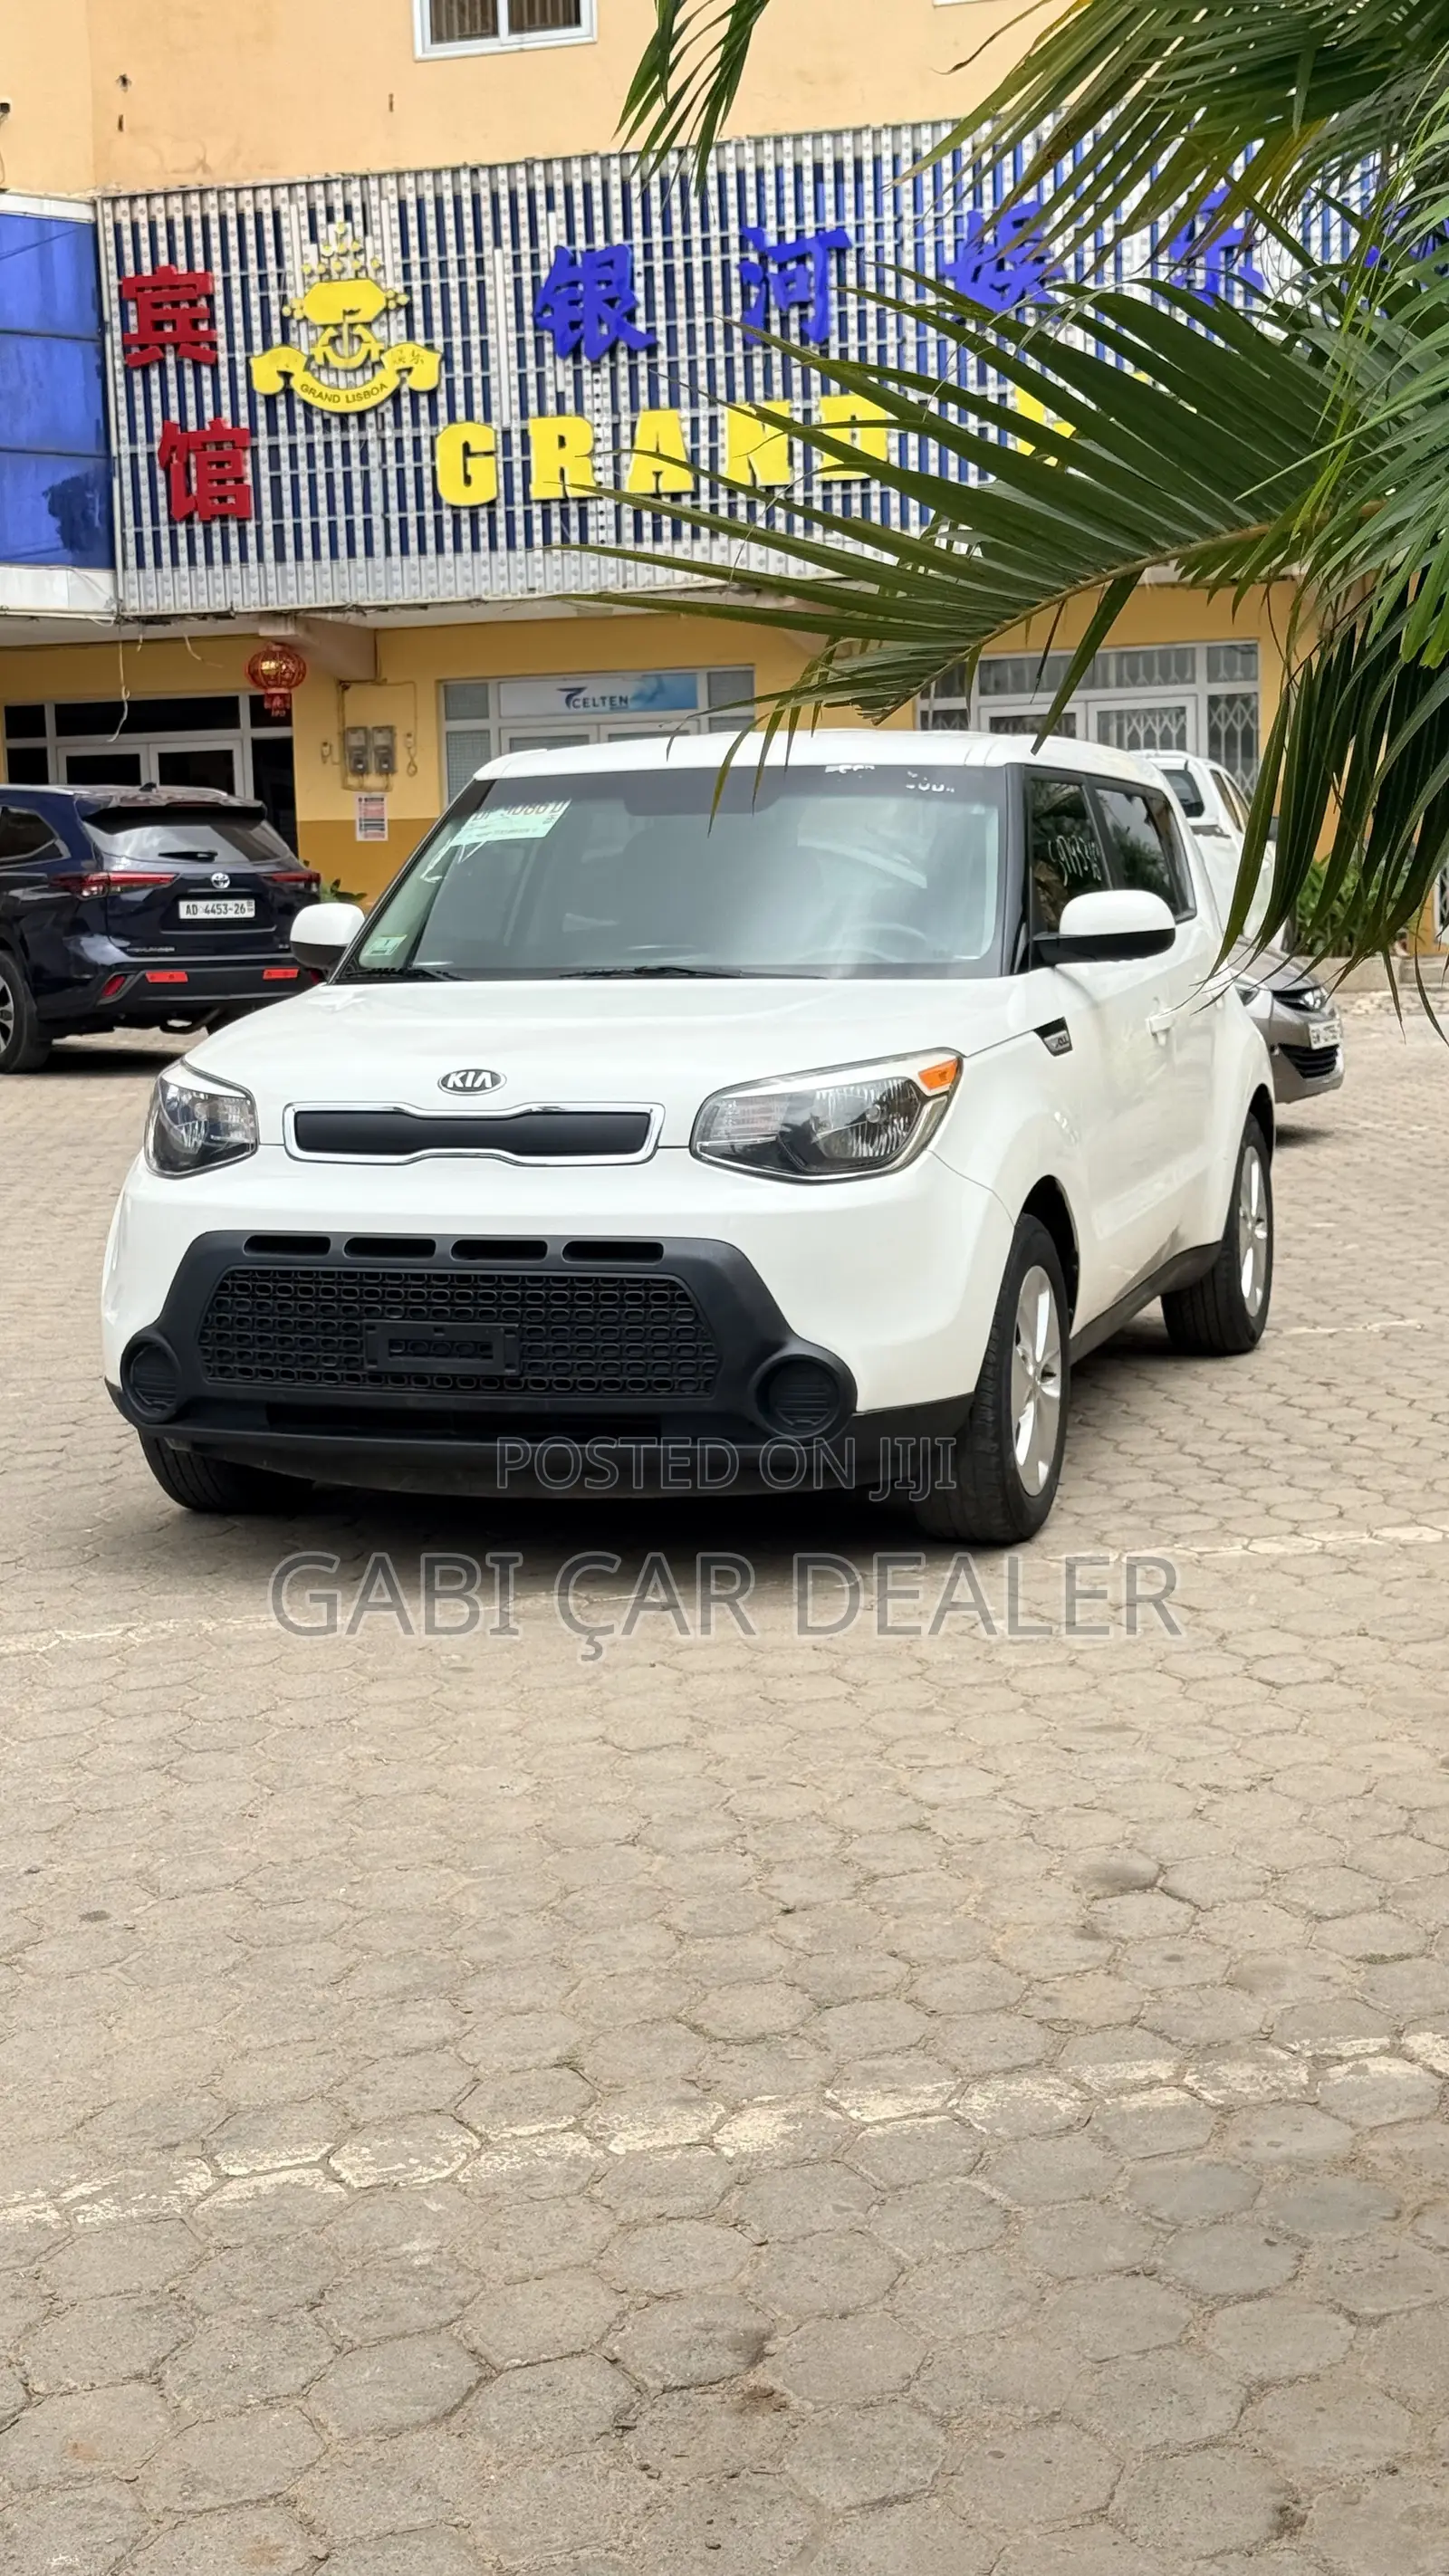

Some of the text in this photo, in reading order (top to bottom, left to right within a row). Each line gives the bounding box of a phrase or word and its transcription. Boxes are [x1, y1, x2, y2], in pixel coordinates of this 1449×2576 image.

[121, 264, 251, 522] 宾馆
[300, 382, 388, 404] GRAND LISBOA
[436, 392, 889, 507] GRAND
[572, 694, 629, 709] CELTEN
[185, 904, 198, 916] AD
[204, 903, 246, 915] 4453-26
[445, 1070, 494, 1089] KIA
